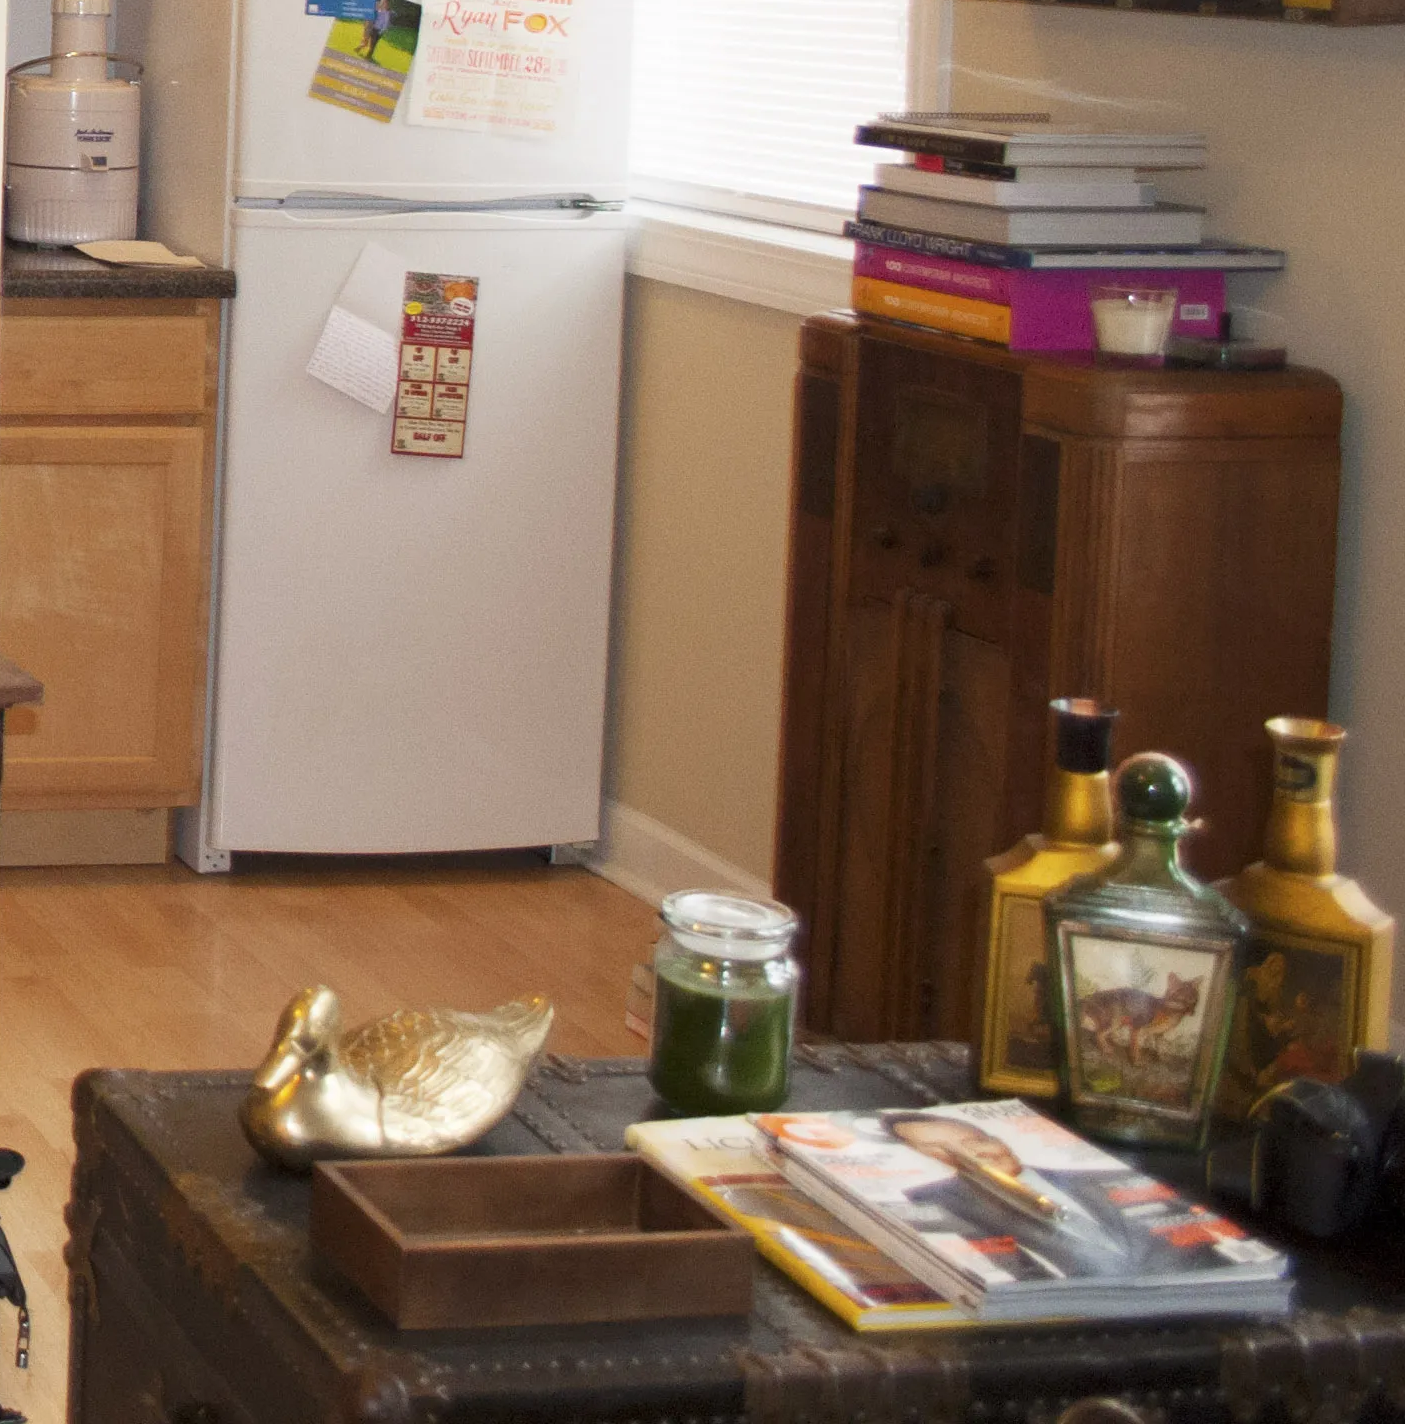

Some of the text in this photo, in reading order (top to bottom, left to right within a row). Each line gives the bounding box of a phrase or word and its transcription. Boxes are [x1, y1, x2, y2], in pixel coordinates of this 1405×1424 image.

[432, 0, 571, 37] Ryan FOX
[467, 48, 523, 72] SEPTEMBER
[849, 224, 879, 241] FRANK
[924, 235, 976, 256] WRIGHT
